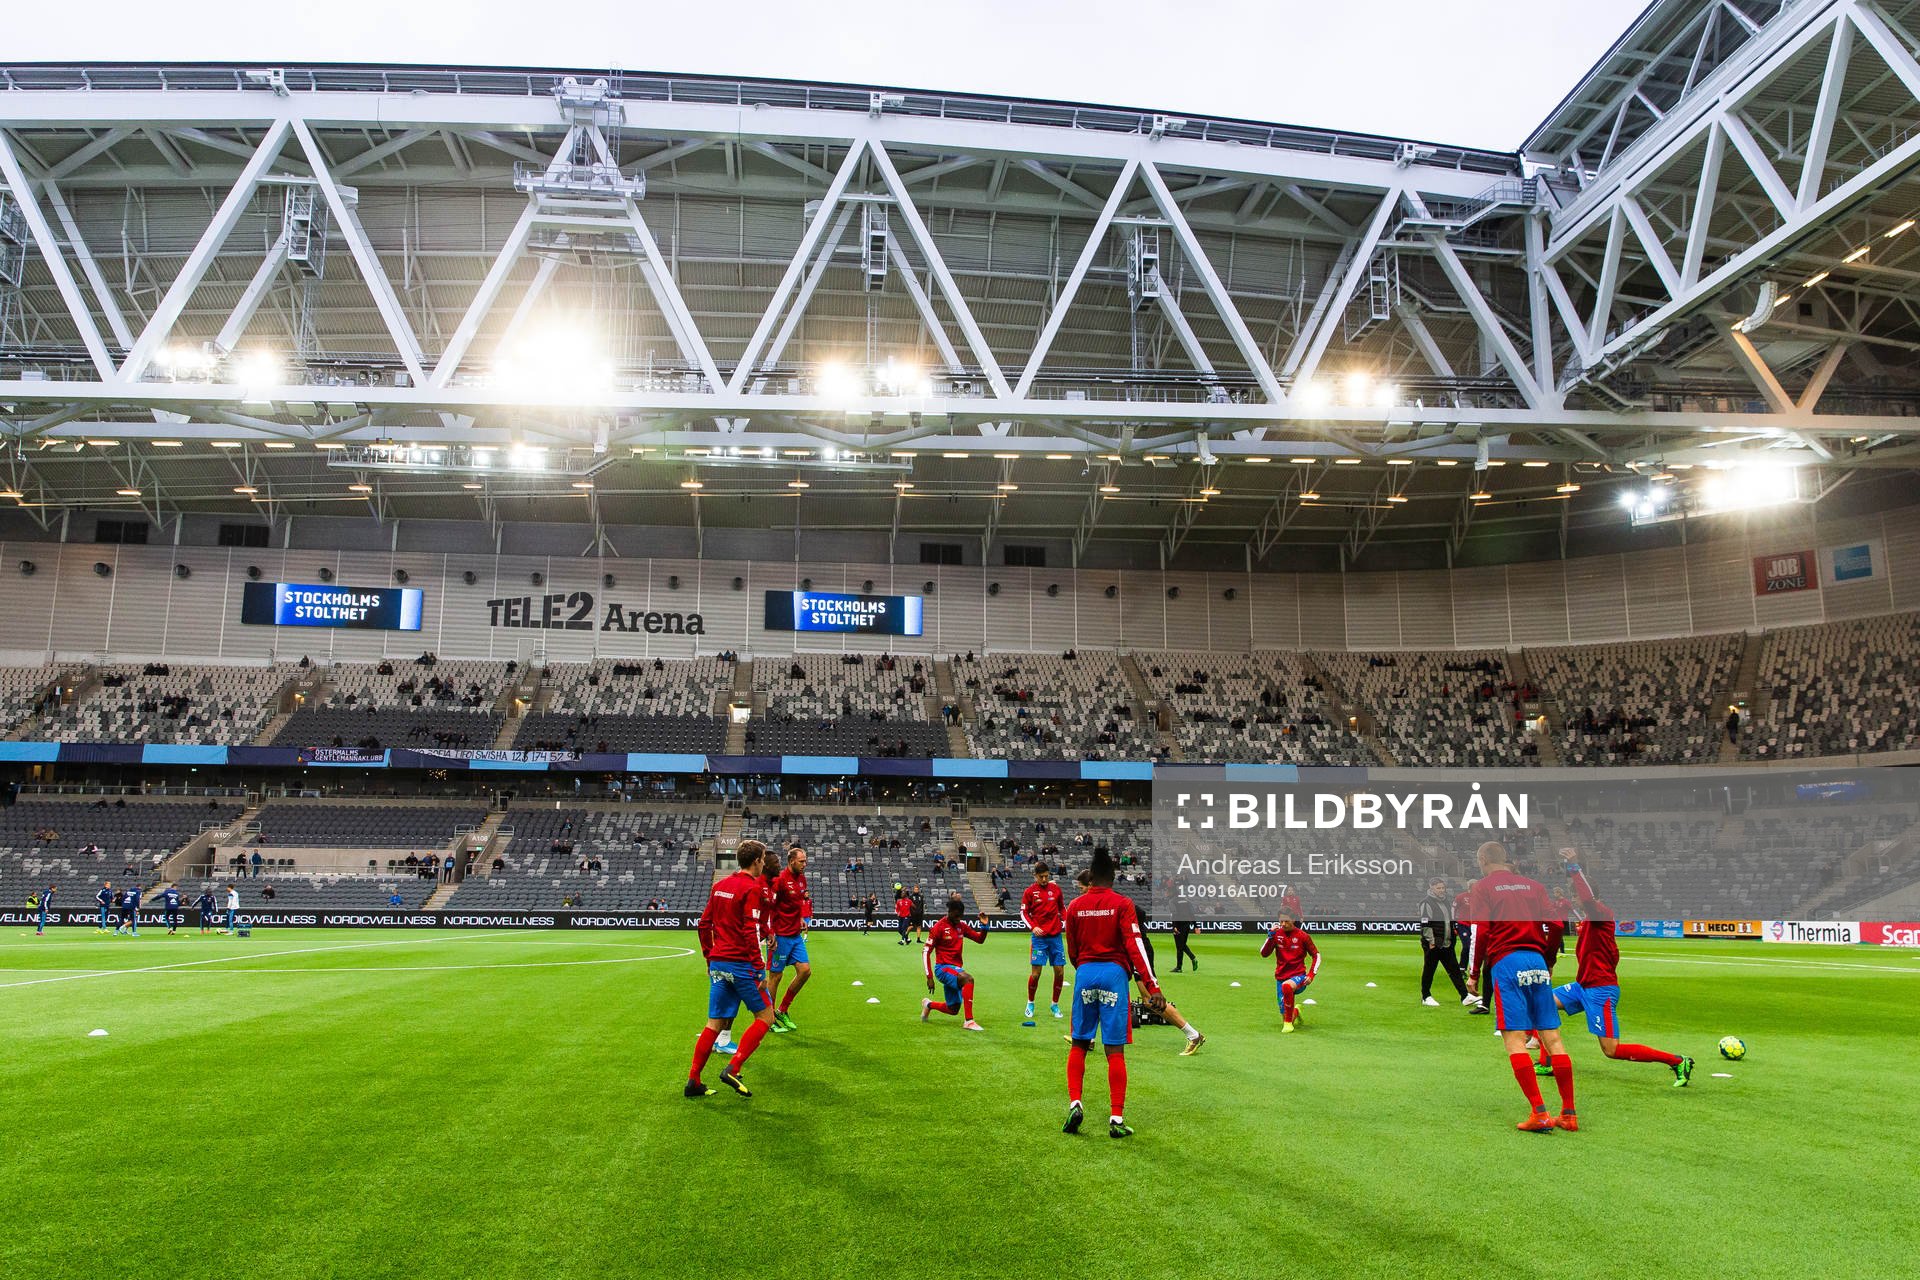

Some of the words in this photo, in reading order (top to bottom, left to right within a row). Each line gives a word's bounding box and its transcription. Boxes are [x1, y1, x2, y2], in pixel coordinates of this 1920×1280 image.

[1768, 558, 1799, 578] JOB
[1767, 577, 1806, 591] ZONE
[284, 591, 380, 607] STOCKHOLMS
[801, 598, 886, 614] STOCKHOLMS
[295, 605, 368, 620] STOLTHET
[487, 591, 594, 631] TELE2
[601, 603, 705, 635] Arena
[811, 612, 875, 626] STOLTHET
[475, 750, 507, 760] SWISHA
[323, 915, 436, 925] NORDICWELLNESS
[443, 916, 555, 926] NORDICWELLNESS
[571, 917, 680, 927] NORDICWELLNESS
[1708, 923, 1736, 932] HECO
[1788, 922, 1851, 942] Thermia
